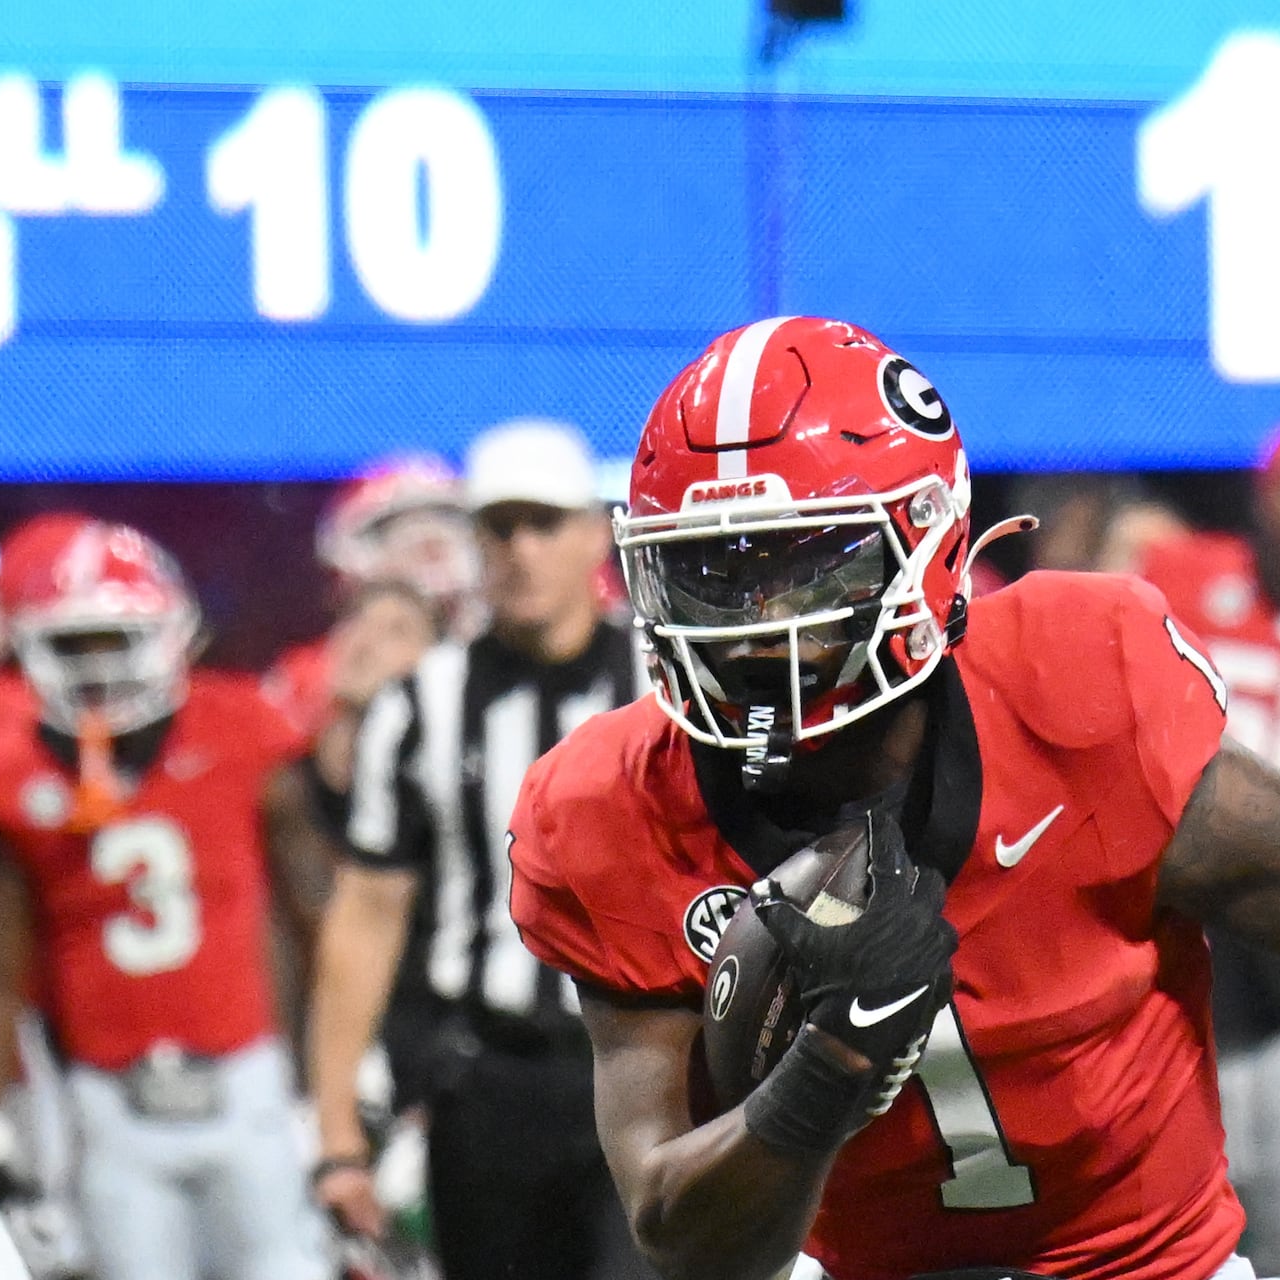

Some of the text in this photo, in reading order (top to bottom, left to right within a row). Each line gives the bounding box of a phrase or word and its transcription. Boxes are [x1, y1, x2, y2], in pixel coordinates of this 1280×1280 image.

[206, 84, 504, 323] 10
[692, 481, 767, 503] DAWGS
[89, 813, 204, 977] 3
[921, 1002, 1036, 1210] 1
